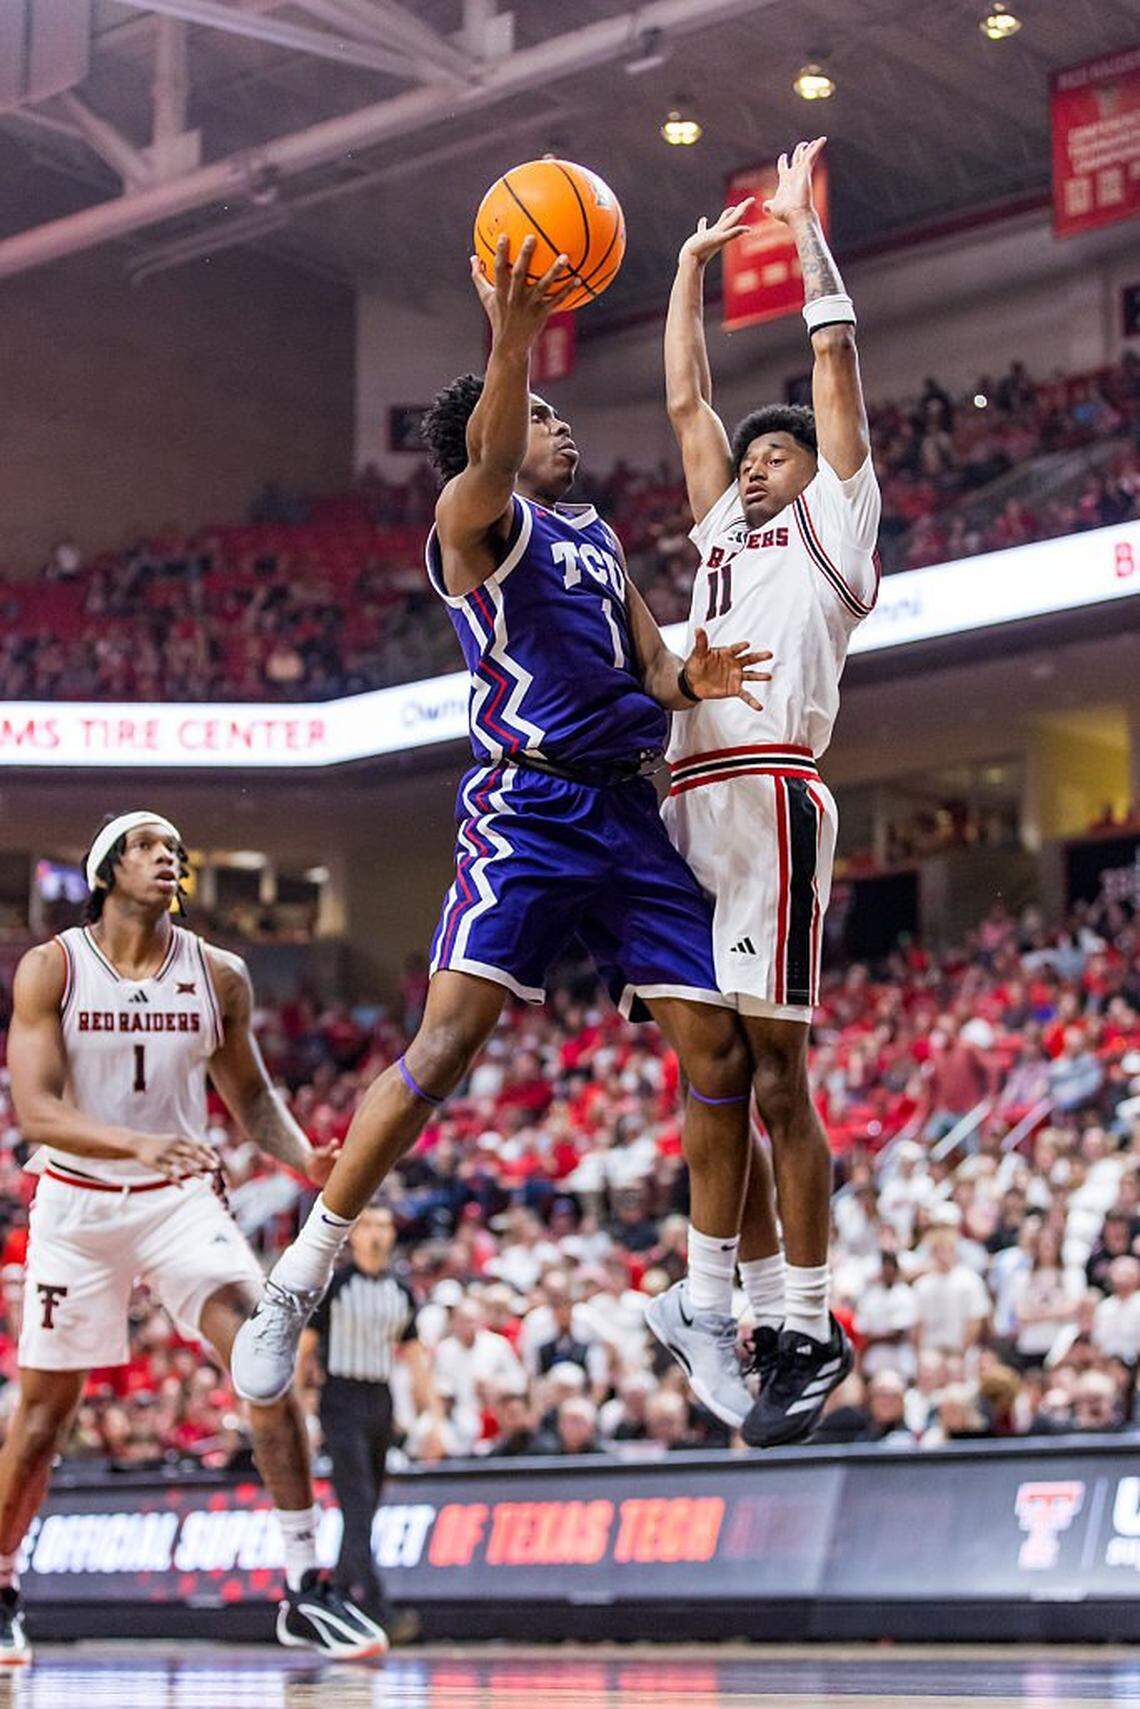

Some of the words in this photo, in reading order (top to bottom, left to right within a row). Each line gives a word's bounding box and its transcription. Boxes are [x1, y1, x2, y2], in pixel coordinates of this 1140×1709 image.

[550, 540, 626, 603] TCU
[705, 526, 790, 570] RERS
[705, 563, 733, 622] 11
[601, 598, 625, 669] 1
[80, 718, 161, 751] TIRE
[176, 718, 328, 751] CENTER
[78, 1010, 115, 1033] RED
[118, 1011, 201, 1034] RAIDERS
[133, 1044, 146, 1092] 1
[427, 1503, 489, 1567] OF
[485, 1499, 615, 1566] TEXAS
[613, 1496, 726, 1564] TECH
